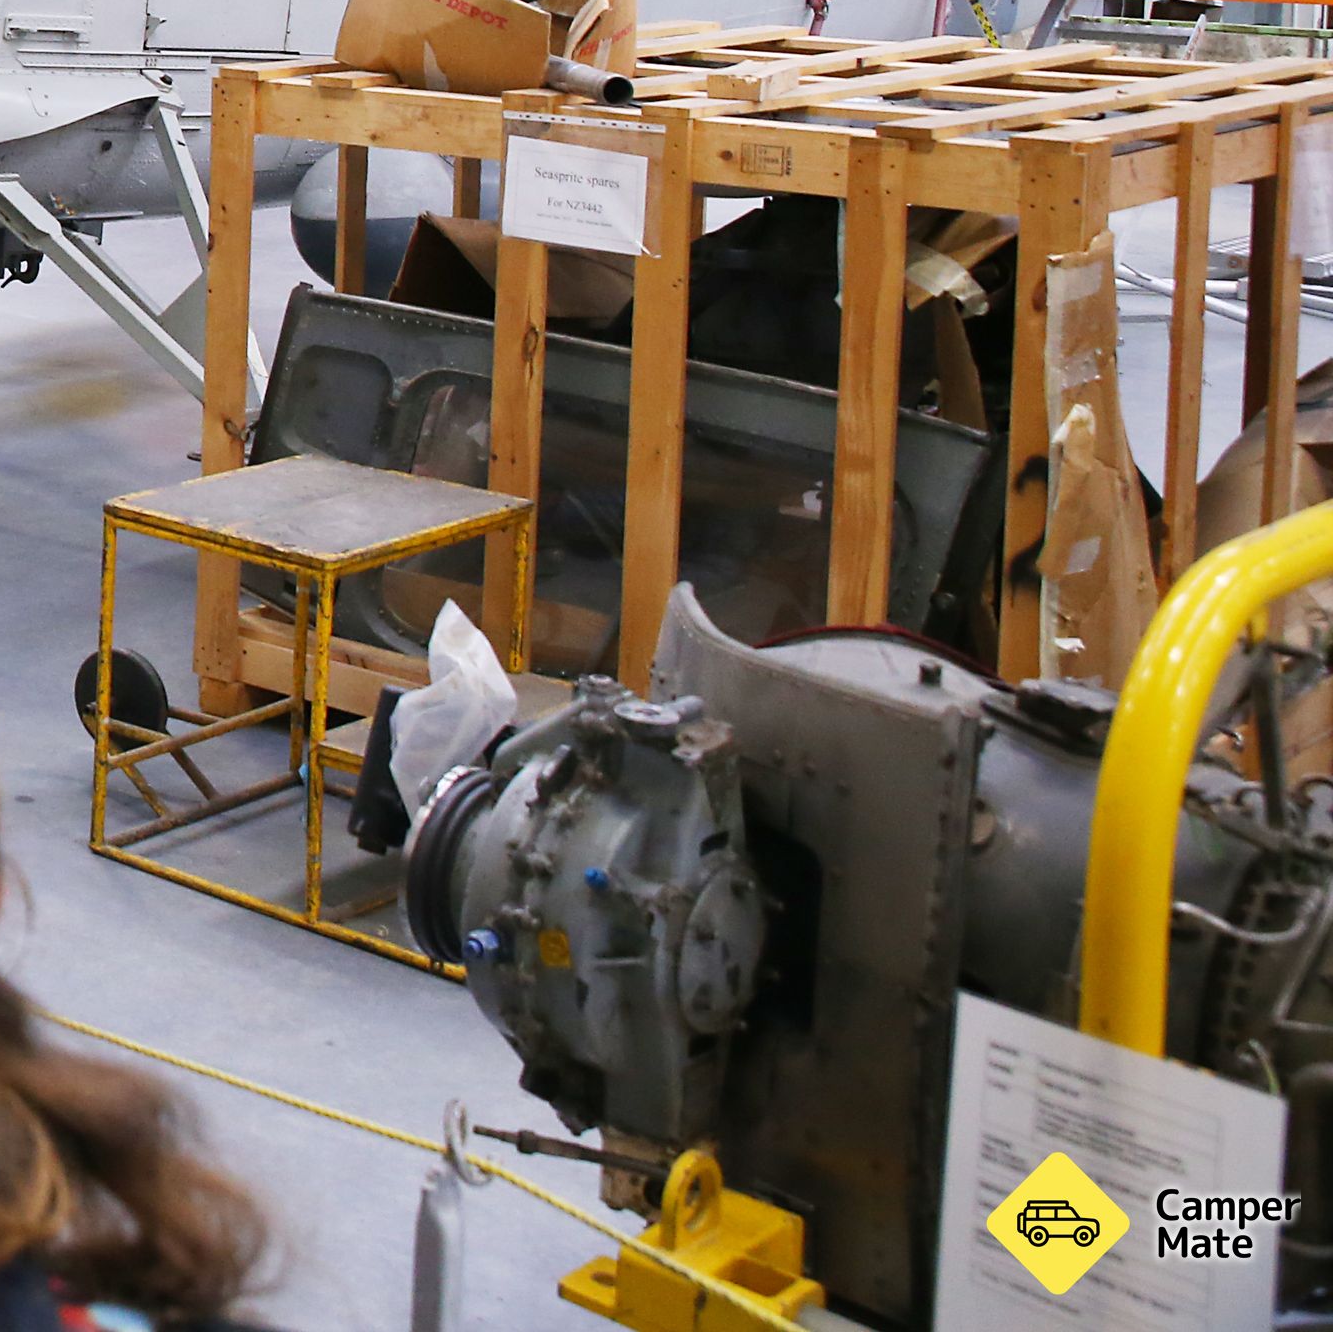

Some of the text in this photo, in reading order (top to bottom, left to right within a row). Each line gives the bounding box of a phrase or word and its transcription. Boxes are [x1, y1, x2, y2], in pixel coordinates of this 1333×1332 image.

[534, 166, 620, 190] Seasprite spares
[546, 196, 563, 208] For
